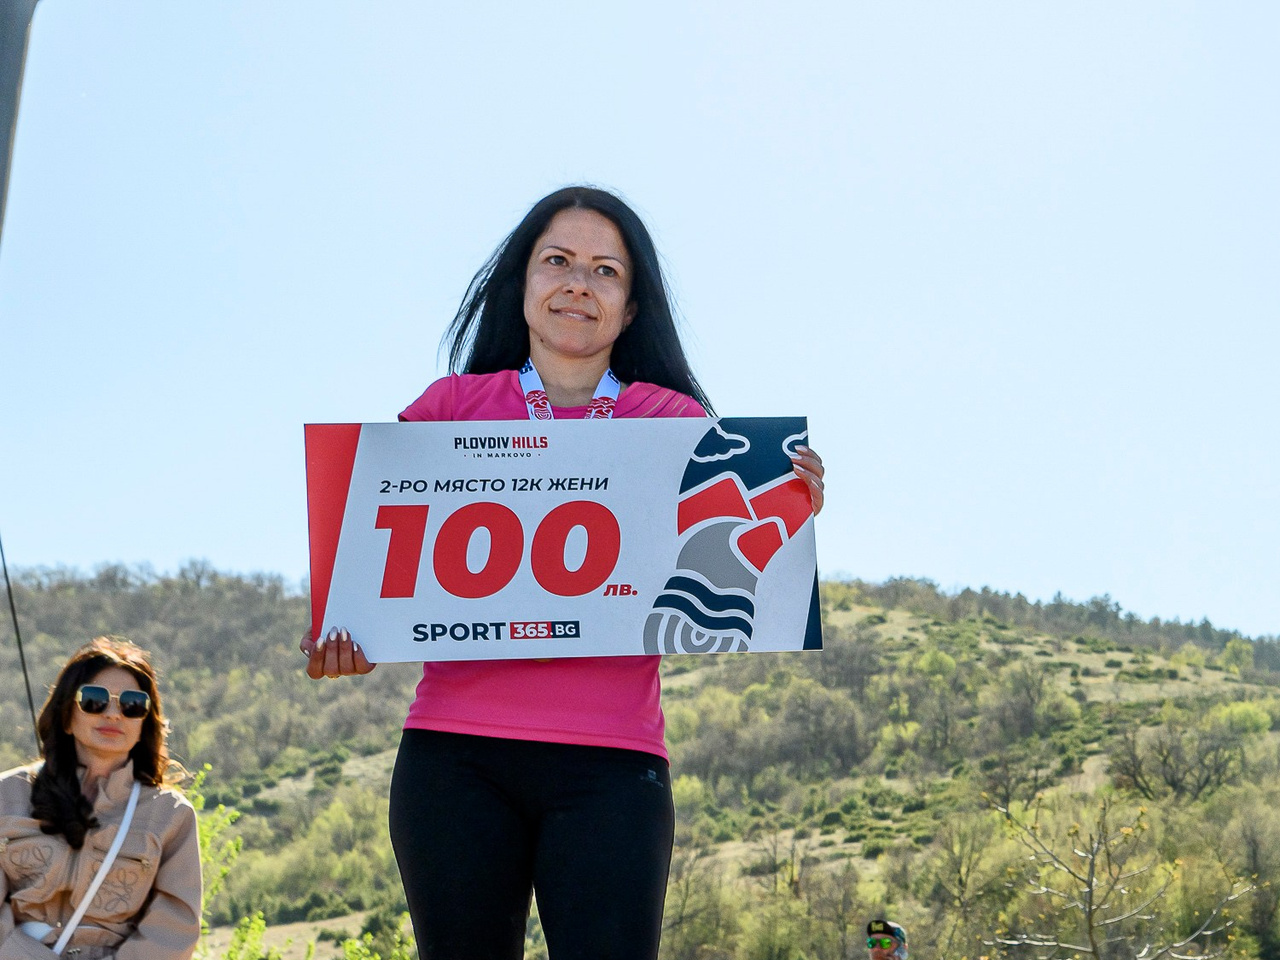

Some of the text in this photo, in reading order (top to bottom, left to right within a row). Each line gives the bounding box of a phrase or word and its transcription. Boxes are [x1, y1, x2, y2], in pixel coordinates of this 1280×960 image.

[454, 436, 549, 450] PLOVDIV HILLS
[380, 480, 428, 493] 2-РО
[434, 479, 506, 493] МЯСТО
[547, 477, 609, 491] ЖЕНИ
[375, 500, 638, 598] 100 лв.
[412, 622, 506, 642] SPORT
